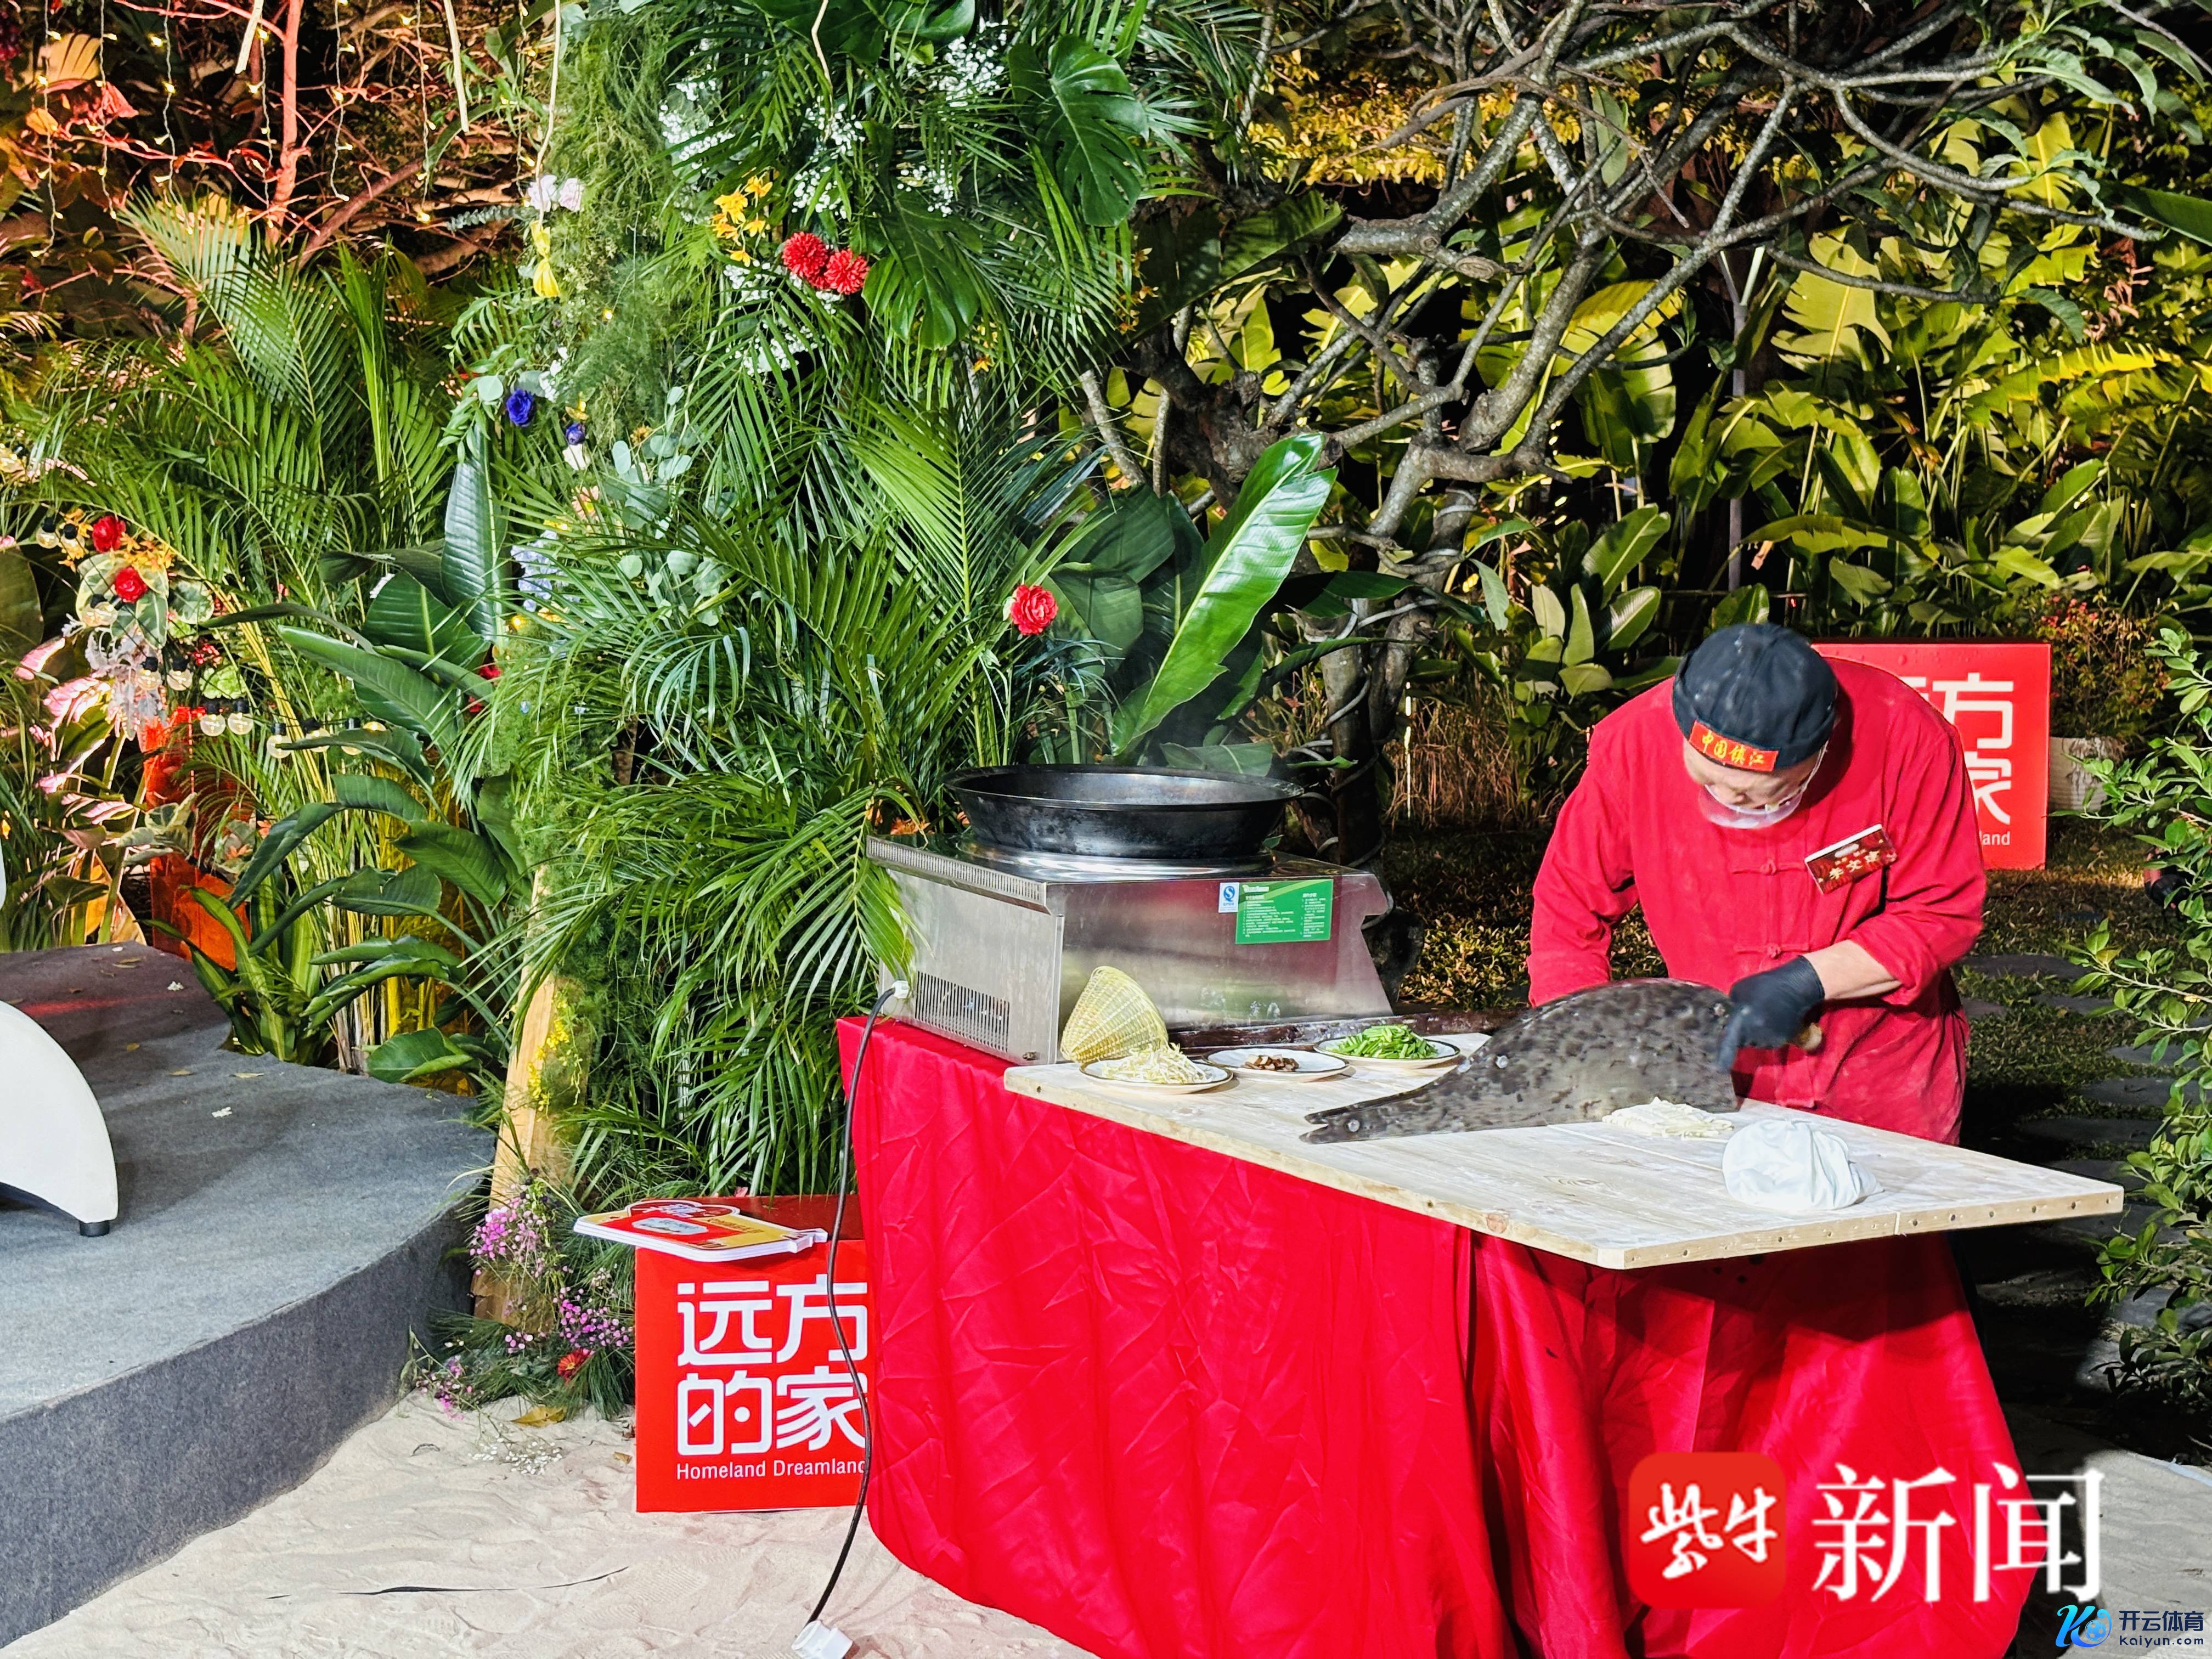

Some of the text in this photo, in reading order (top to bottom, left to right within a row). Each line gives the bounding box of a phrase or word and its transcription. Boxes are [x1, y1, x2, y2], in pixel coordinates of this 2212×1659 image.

[1702, 730, 1765, 766] 中国镇江
[677, 1274, 868, 1366] 远方
[677, 1365, 868, 1456] 的家
[676, 1460, 766, 1480] Homeland
